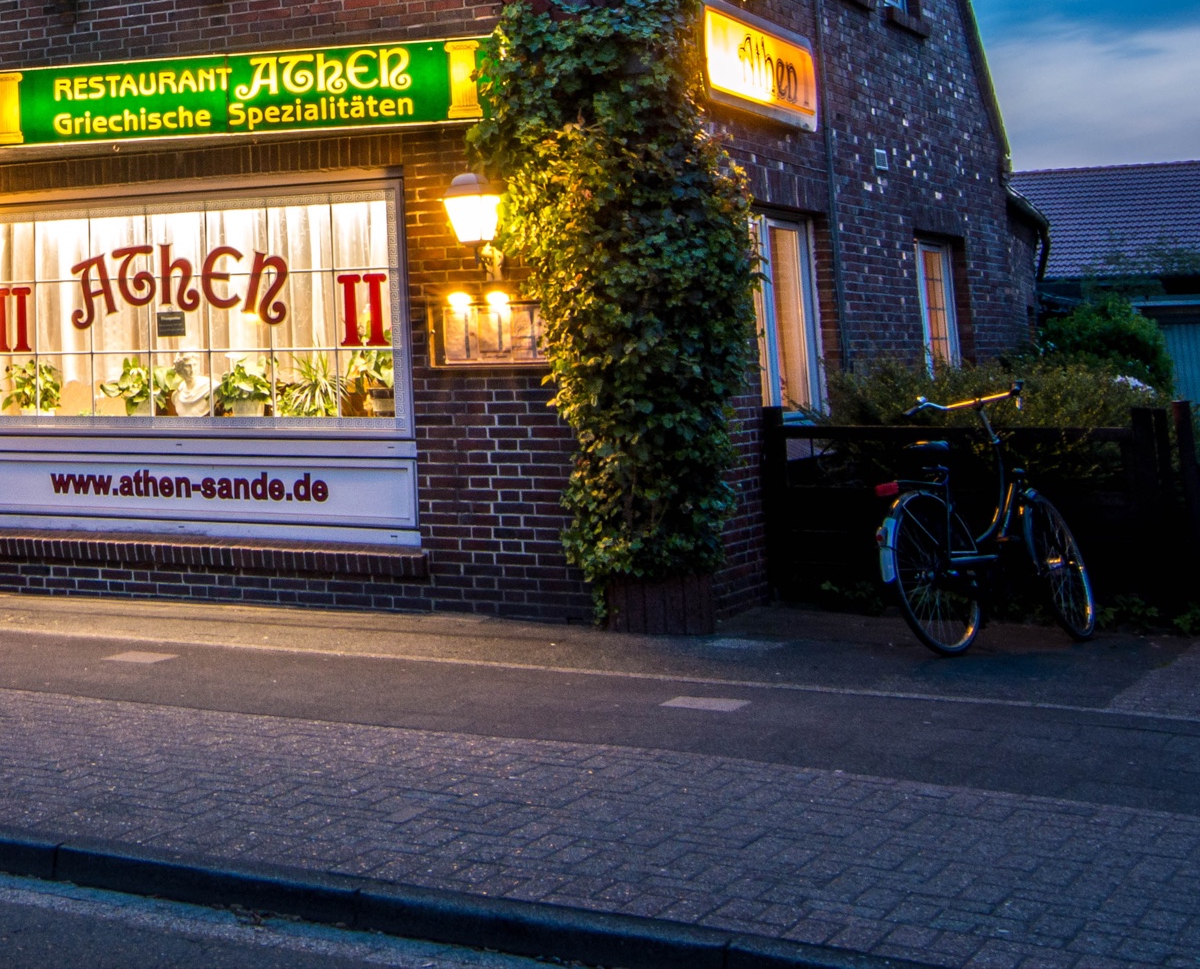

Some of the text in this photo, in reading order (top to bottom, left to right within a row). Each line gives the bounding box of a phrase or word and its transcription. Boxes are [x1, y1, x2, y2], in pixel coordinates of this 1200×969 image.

[54, 67, 233, 101] RESTAURANT
[54, 96, 414, 135] Griechische Spezialitäten
[51, 470, 329, 503] www.athen-sande.de
